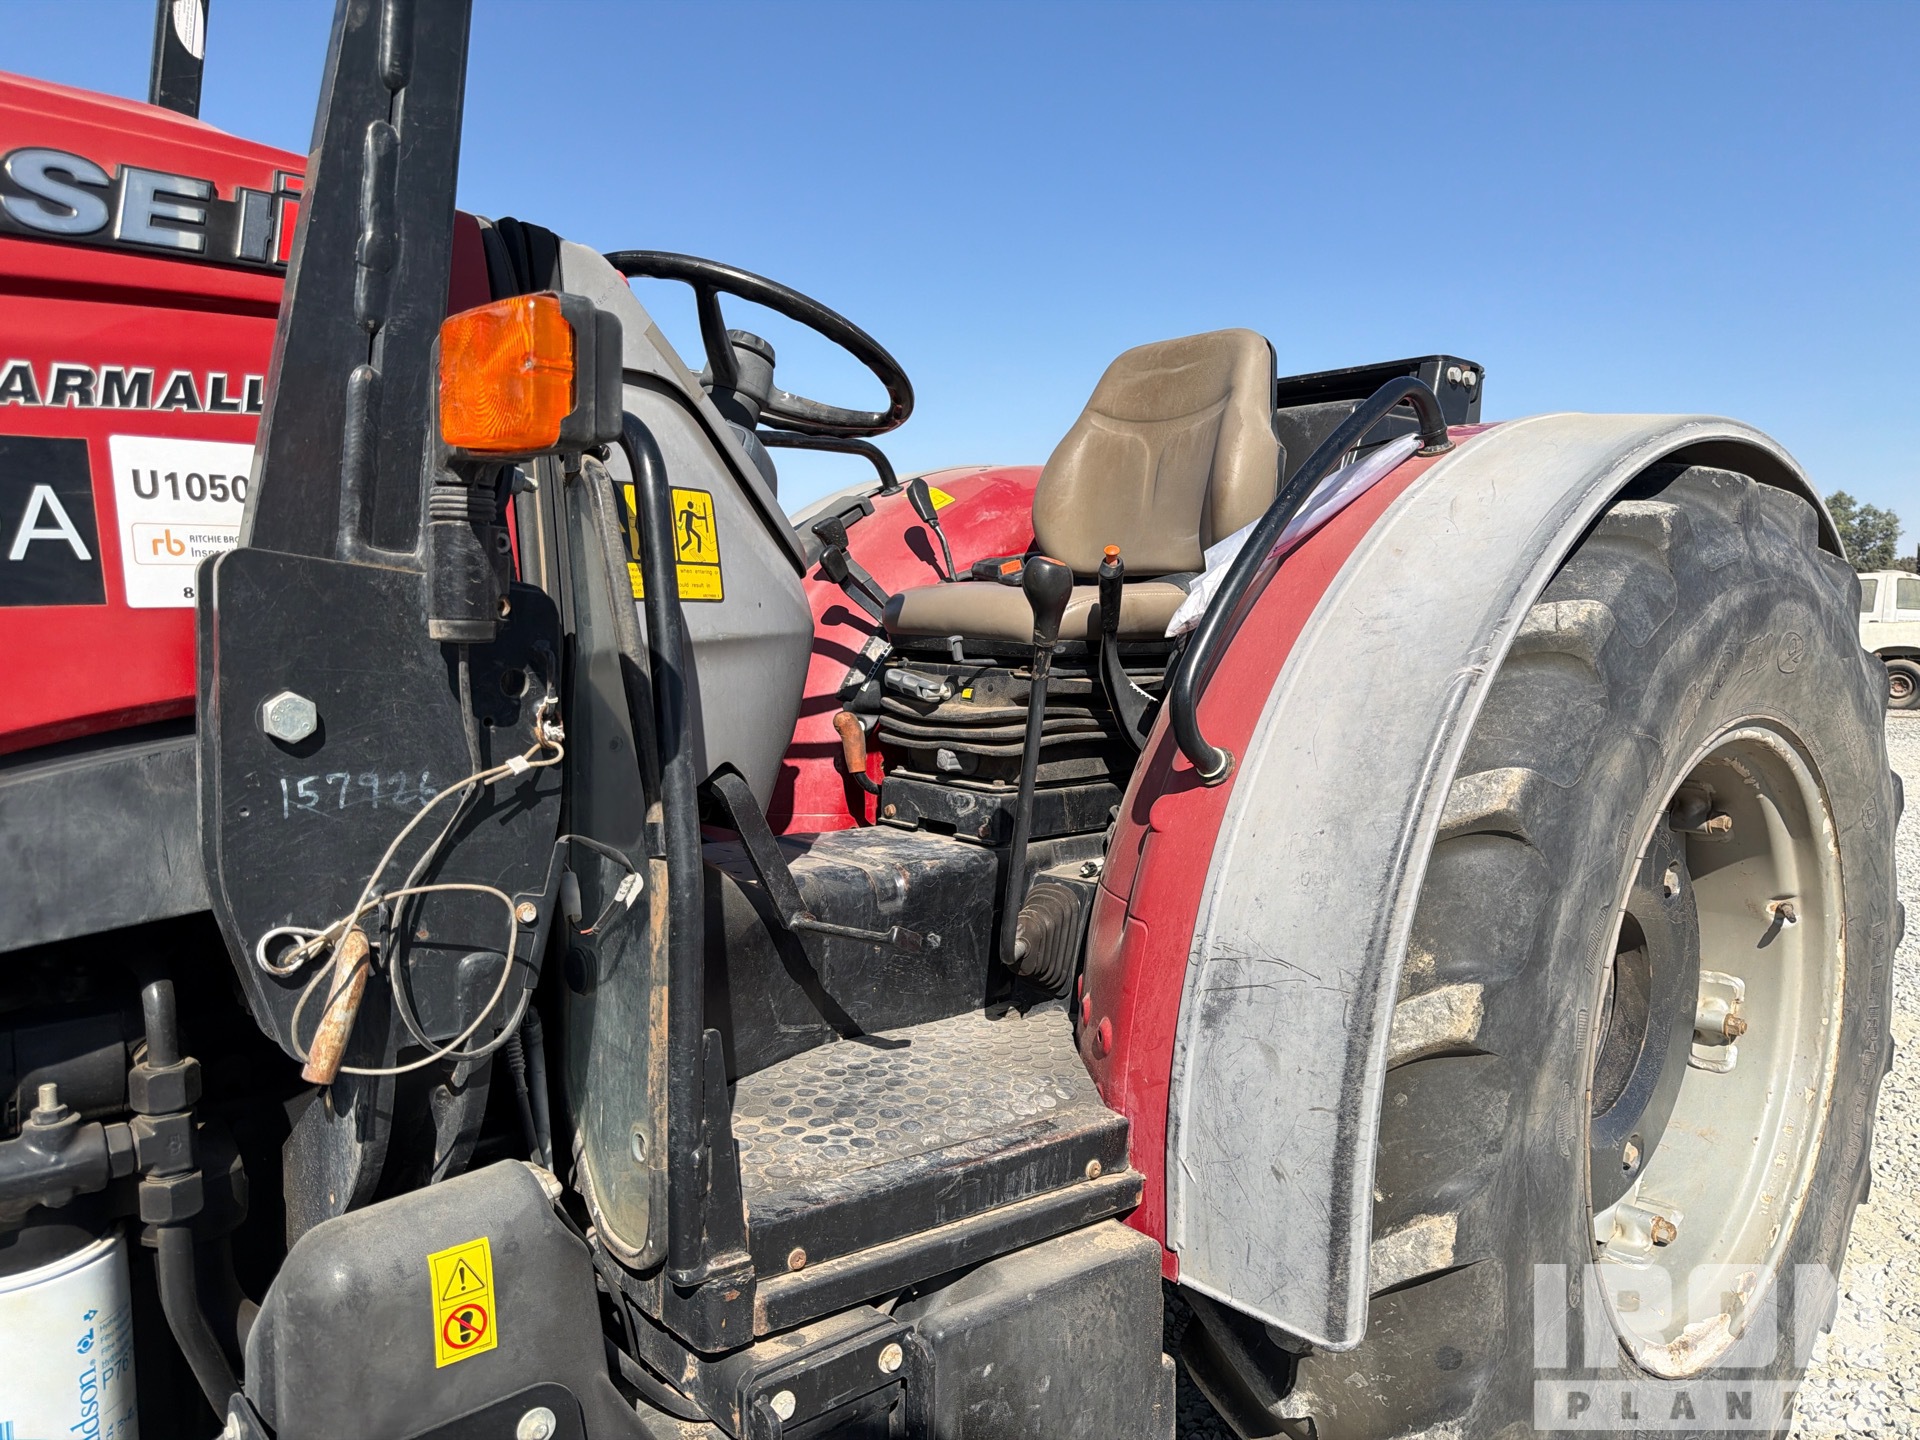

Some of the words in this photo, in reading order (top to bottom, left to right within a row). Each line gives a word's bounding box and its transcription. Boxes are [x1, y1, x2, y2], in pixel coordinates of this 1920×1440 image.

[0, 360, 264, 415] ARMALL
[131, 469, 249, 504] U1050
[9, 485, 92, 561] A
[189, 535, 222, 544] RITCHIE
